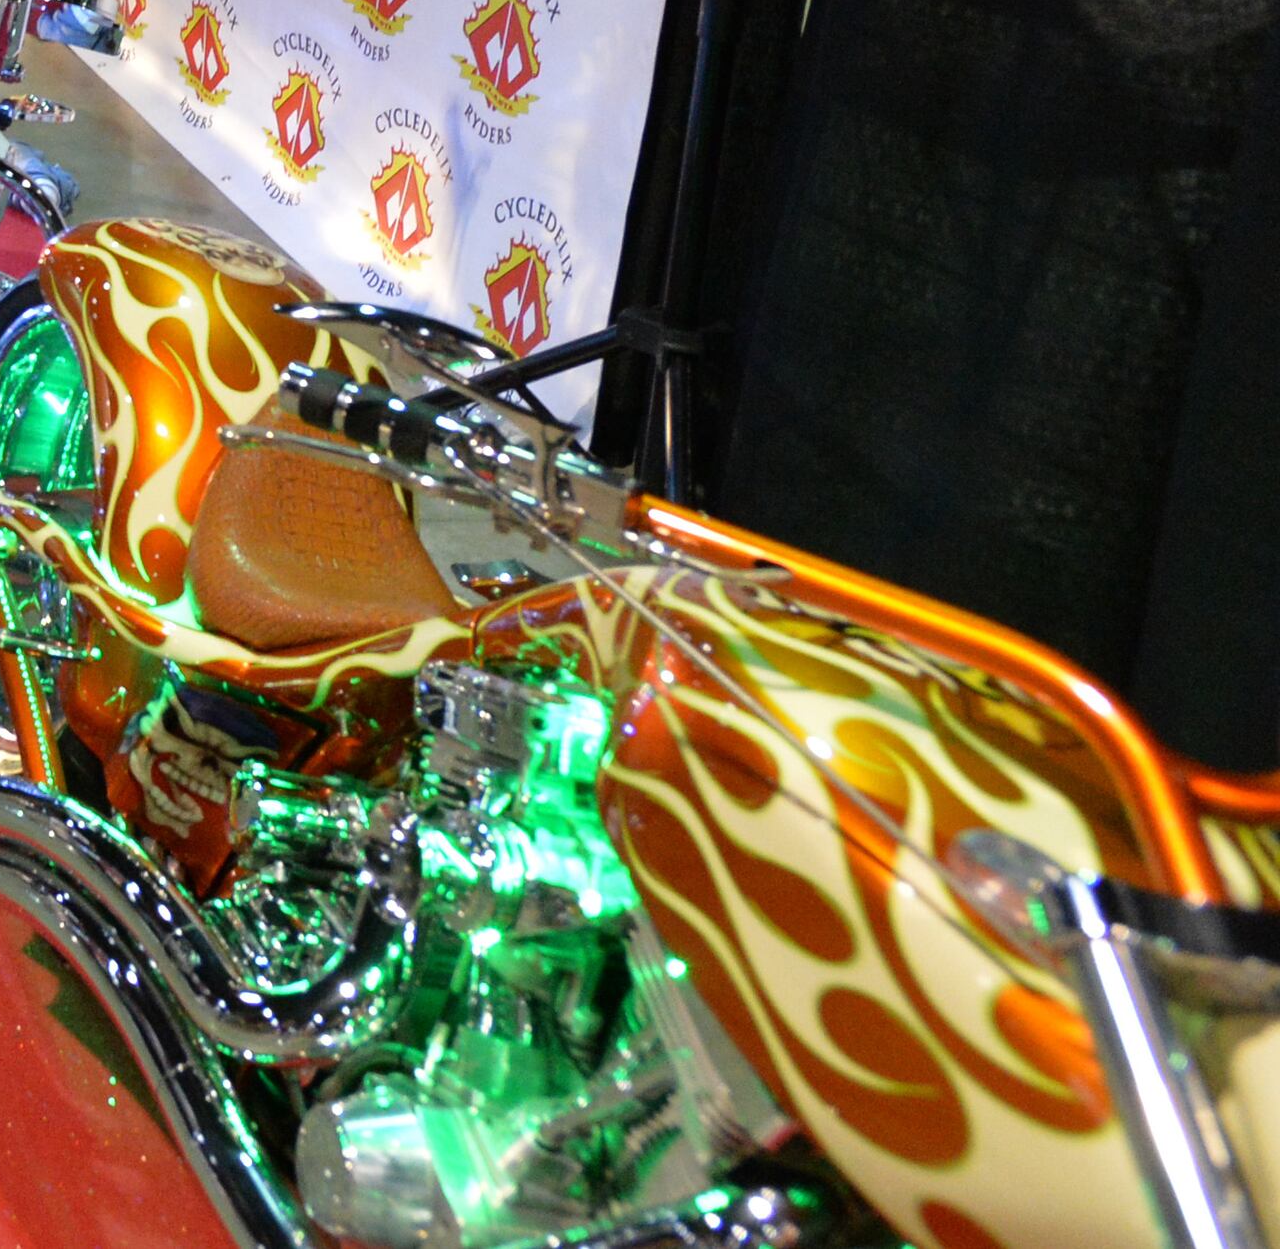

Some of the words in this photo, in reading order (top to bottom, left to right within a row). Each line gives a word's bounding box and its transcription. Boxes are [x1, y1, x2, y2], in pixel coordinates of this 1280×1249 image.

[351, 25, 389, 61] RYDERS
[273, 33, 341, 103] CYCLEDELIX
[180, 97, 213, 130] RYDERS
[478, 80, 514, 112] ATLANTA
[465, 103, 511, 144] RYDERS
[376, 108, 454, 186] CYCLEDELIX
[262, 172, 302, 207] RYDERS
[494, 197, 573, 285] CYCLEDELIX
